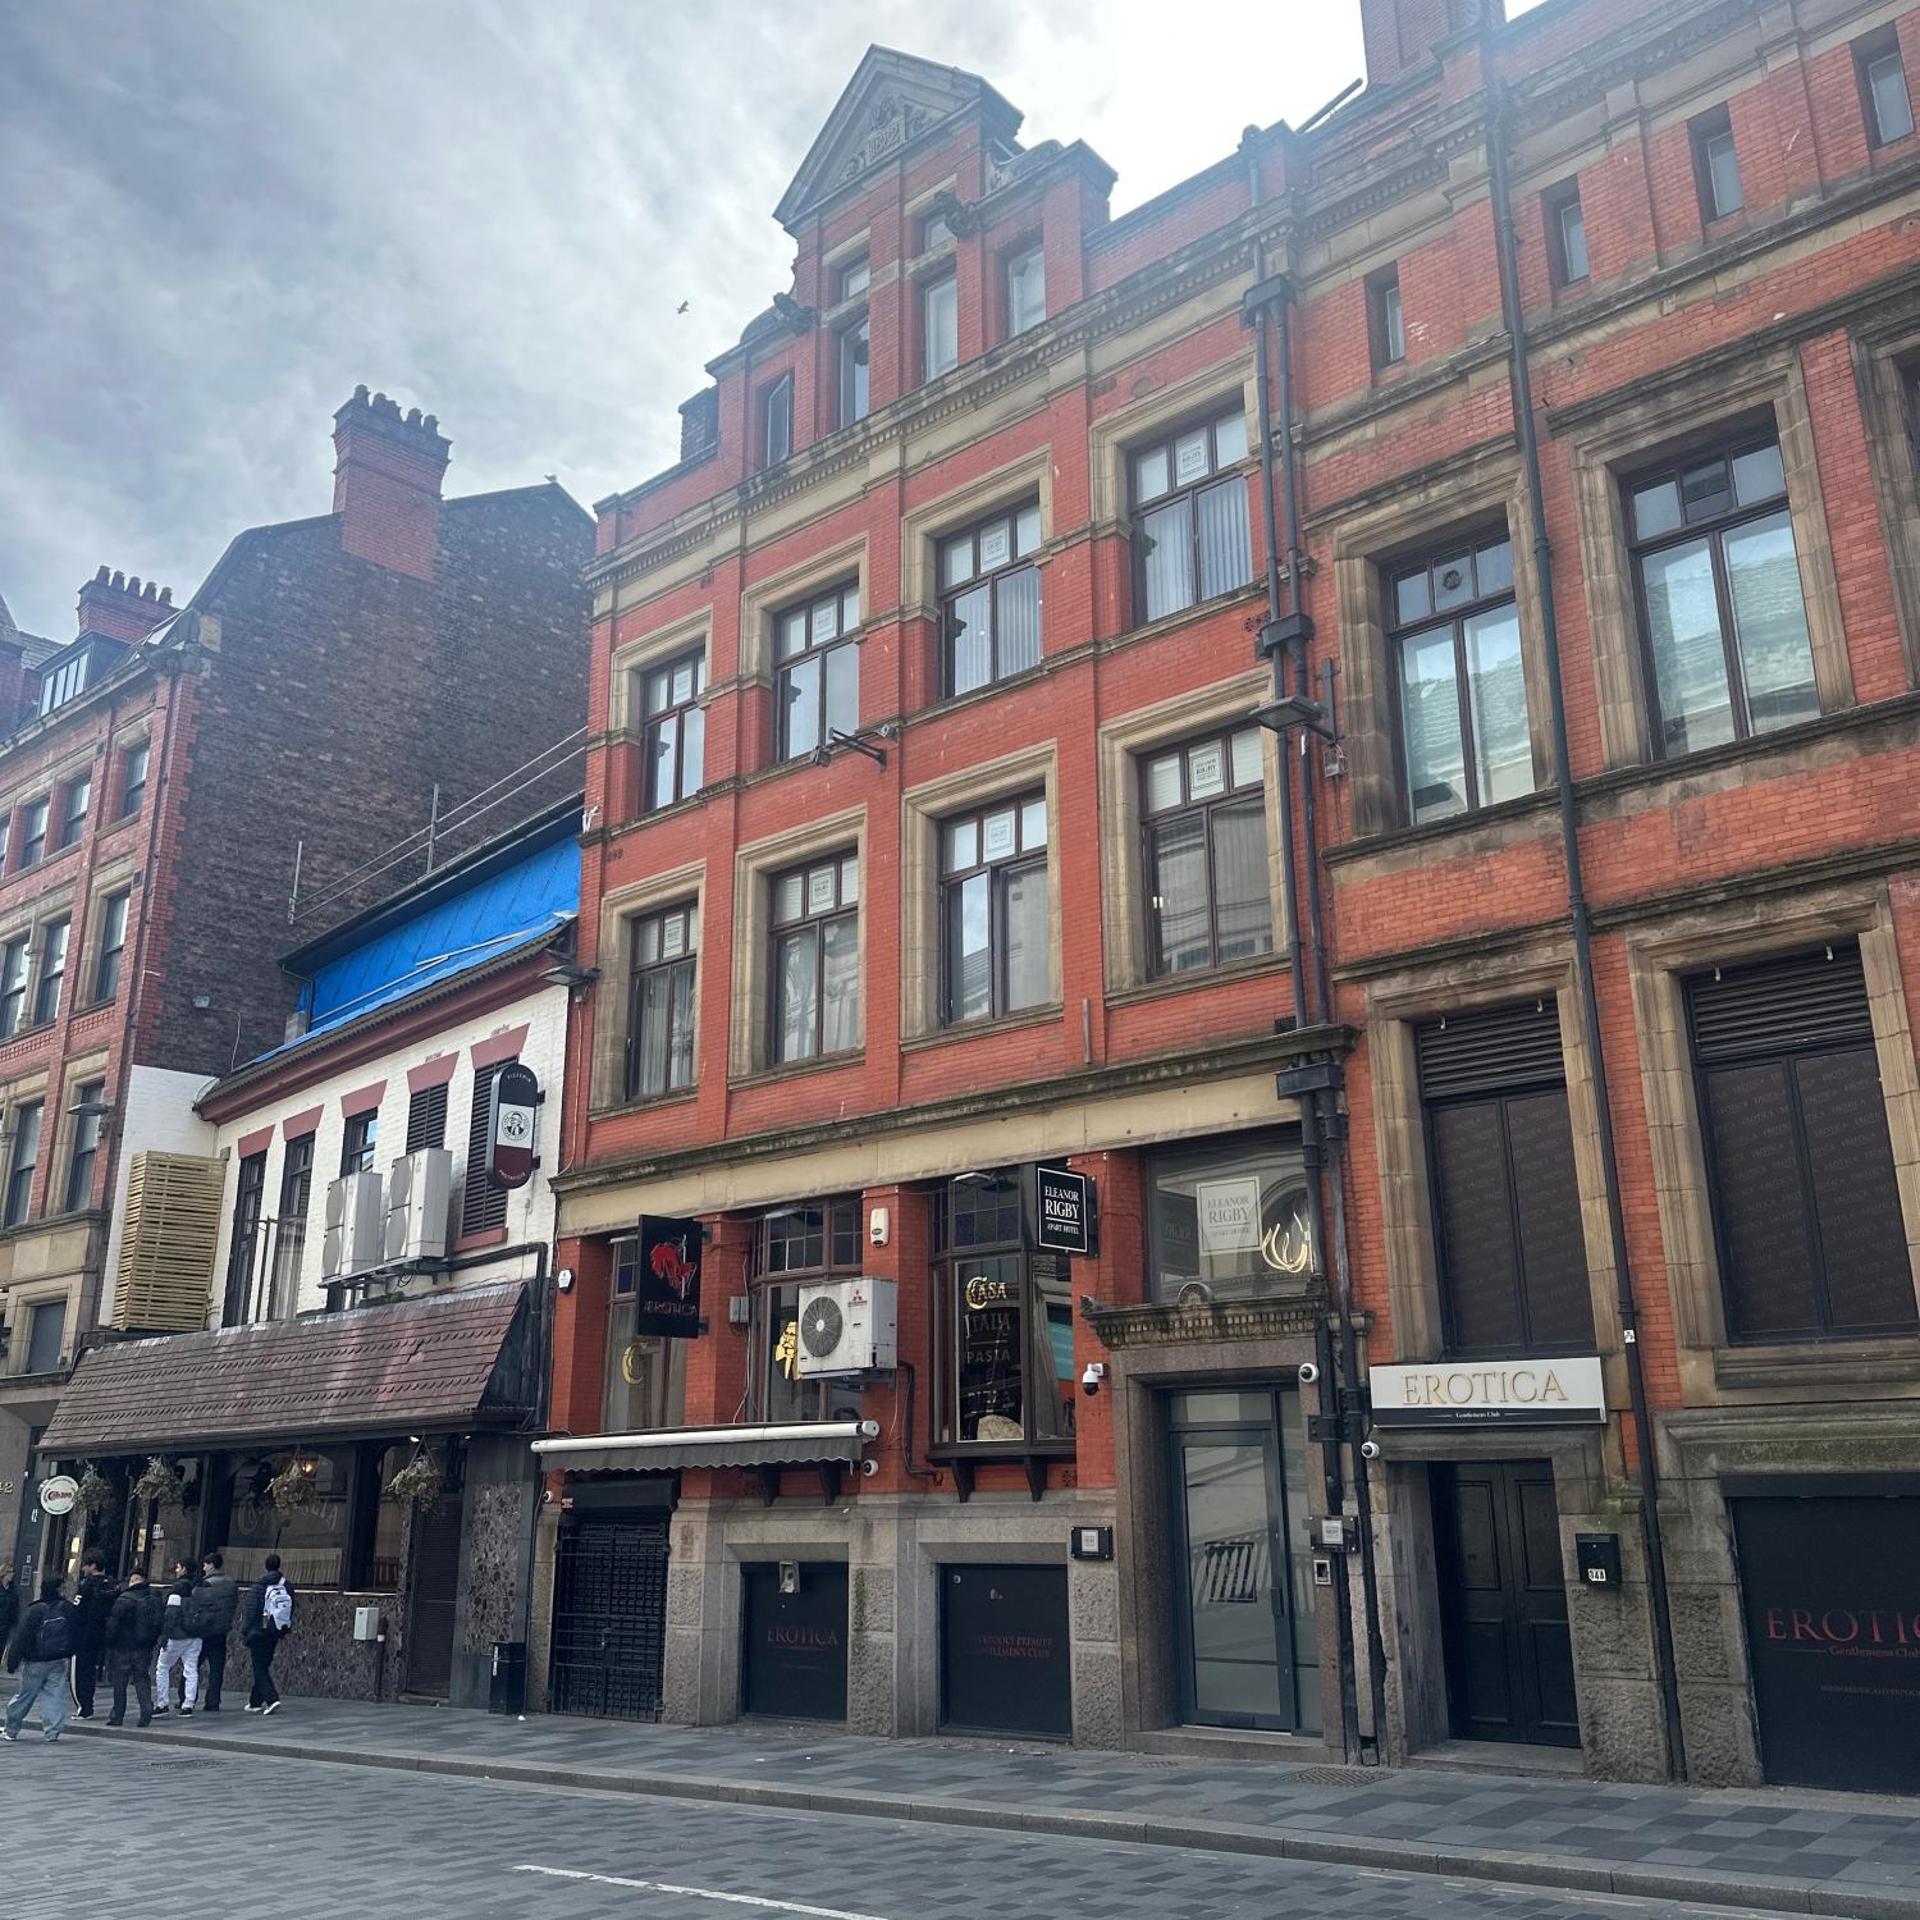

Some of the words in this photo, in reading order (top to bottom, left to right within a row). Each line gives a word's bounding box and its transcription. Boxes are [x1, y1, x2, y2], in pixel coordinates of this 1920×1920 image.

[1045, 1186, 1079, 1201] ELEANOR
[1045, 1199, 1079, 1219] RIGBY
[1208, 1197, 1249, 1208] ELEANOR
[1209, 1207, 1250, 1223] RIGBY
[967, 1349, 1011, 1364] PASTA
[1402, 1368, 1569, 1406] EROTICA
[1487, 1409, 1501, 1418] Club
[73, 1595, 82, 1606] 5
[1766, 1608, 1920, 1644] EROTI
[767, 1626, 840, 1648] EROTICA
[1828, 1645, 1895, 1658] Gentlemens
